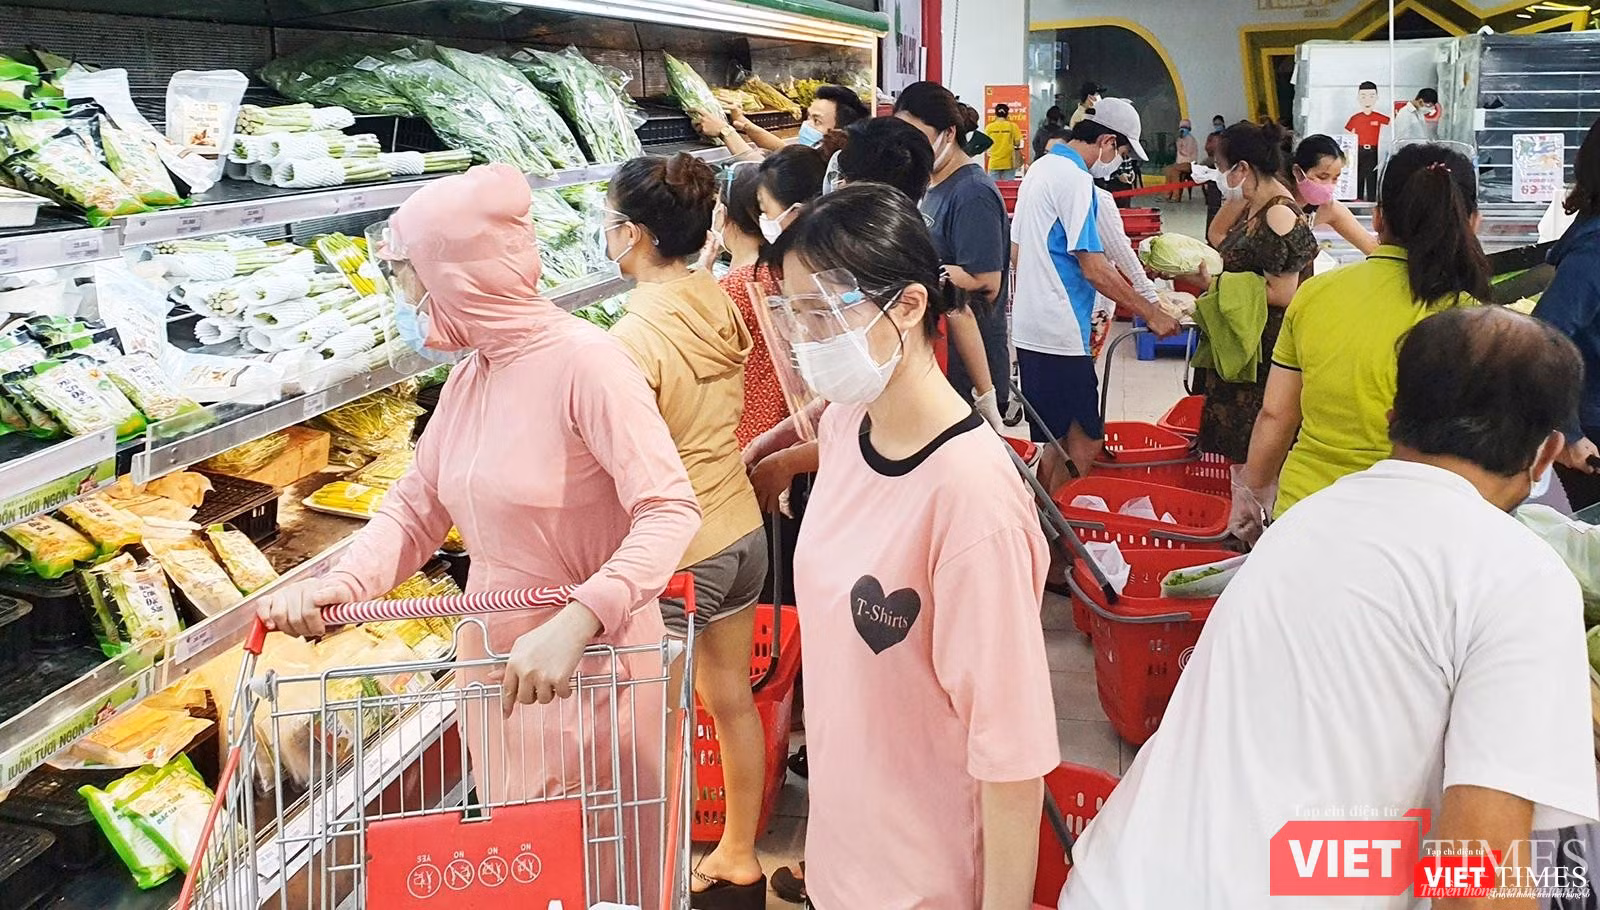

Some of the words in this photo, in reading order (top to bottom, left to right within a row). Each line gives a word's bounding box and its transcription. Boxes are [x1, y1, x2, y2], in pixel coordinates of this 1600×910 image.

[856, 597, 909, 629] T-Shirts
[59, 721, 86, 748] NGON
[520, 842, 532, 851] NO
[453, 851, 465, 859] NO
[487, 847, 499, 855] NO
[416, 855, 432, 863] YES
